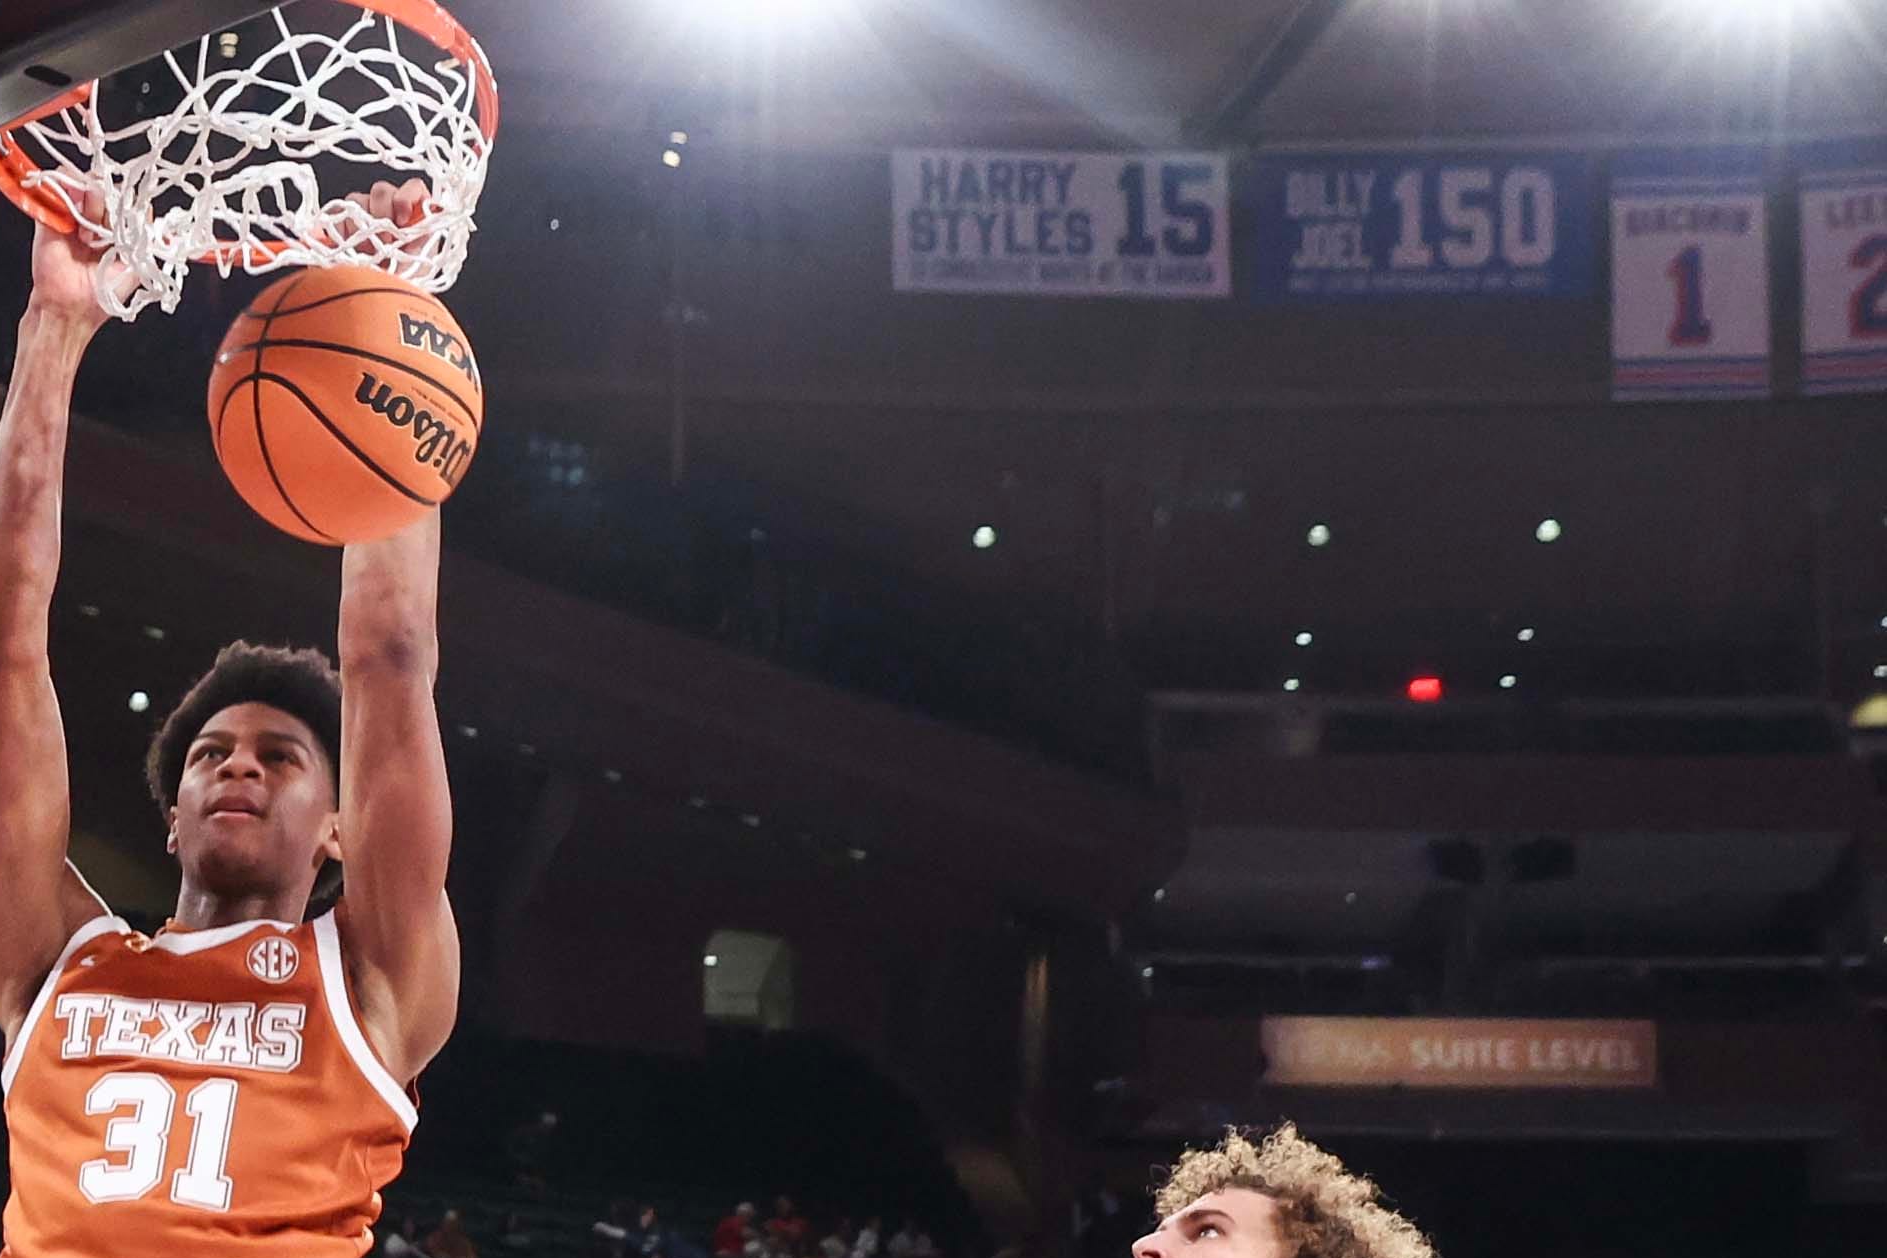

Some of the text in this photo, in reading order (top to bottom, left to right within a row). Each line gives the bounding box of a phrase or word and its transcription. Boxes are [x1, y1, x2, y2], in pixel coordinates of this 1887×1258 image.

[920, 158, 1076, 205] HARRY
[1117, 161, 1213, 257] 15
[1391, 167, 1556, 269] 150
[908, 207, 1096, 257] STYLES
[1667, 244, 1712, 347] 1
[252, 940, 295, 978] SEC
[55, 993, 306, 1073] TEXAS
[1411, 1037, 1514, 1071] SUITE
[1528, 1038, 1639, 1071] LEVEL
[79, 1072, 239, 1212] 31
